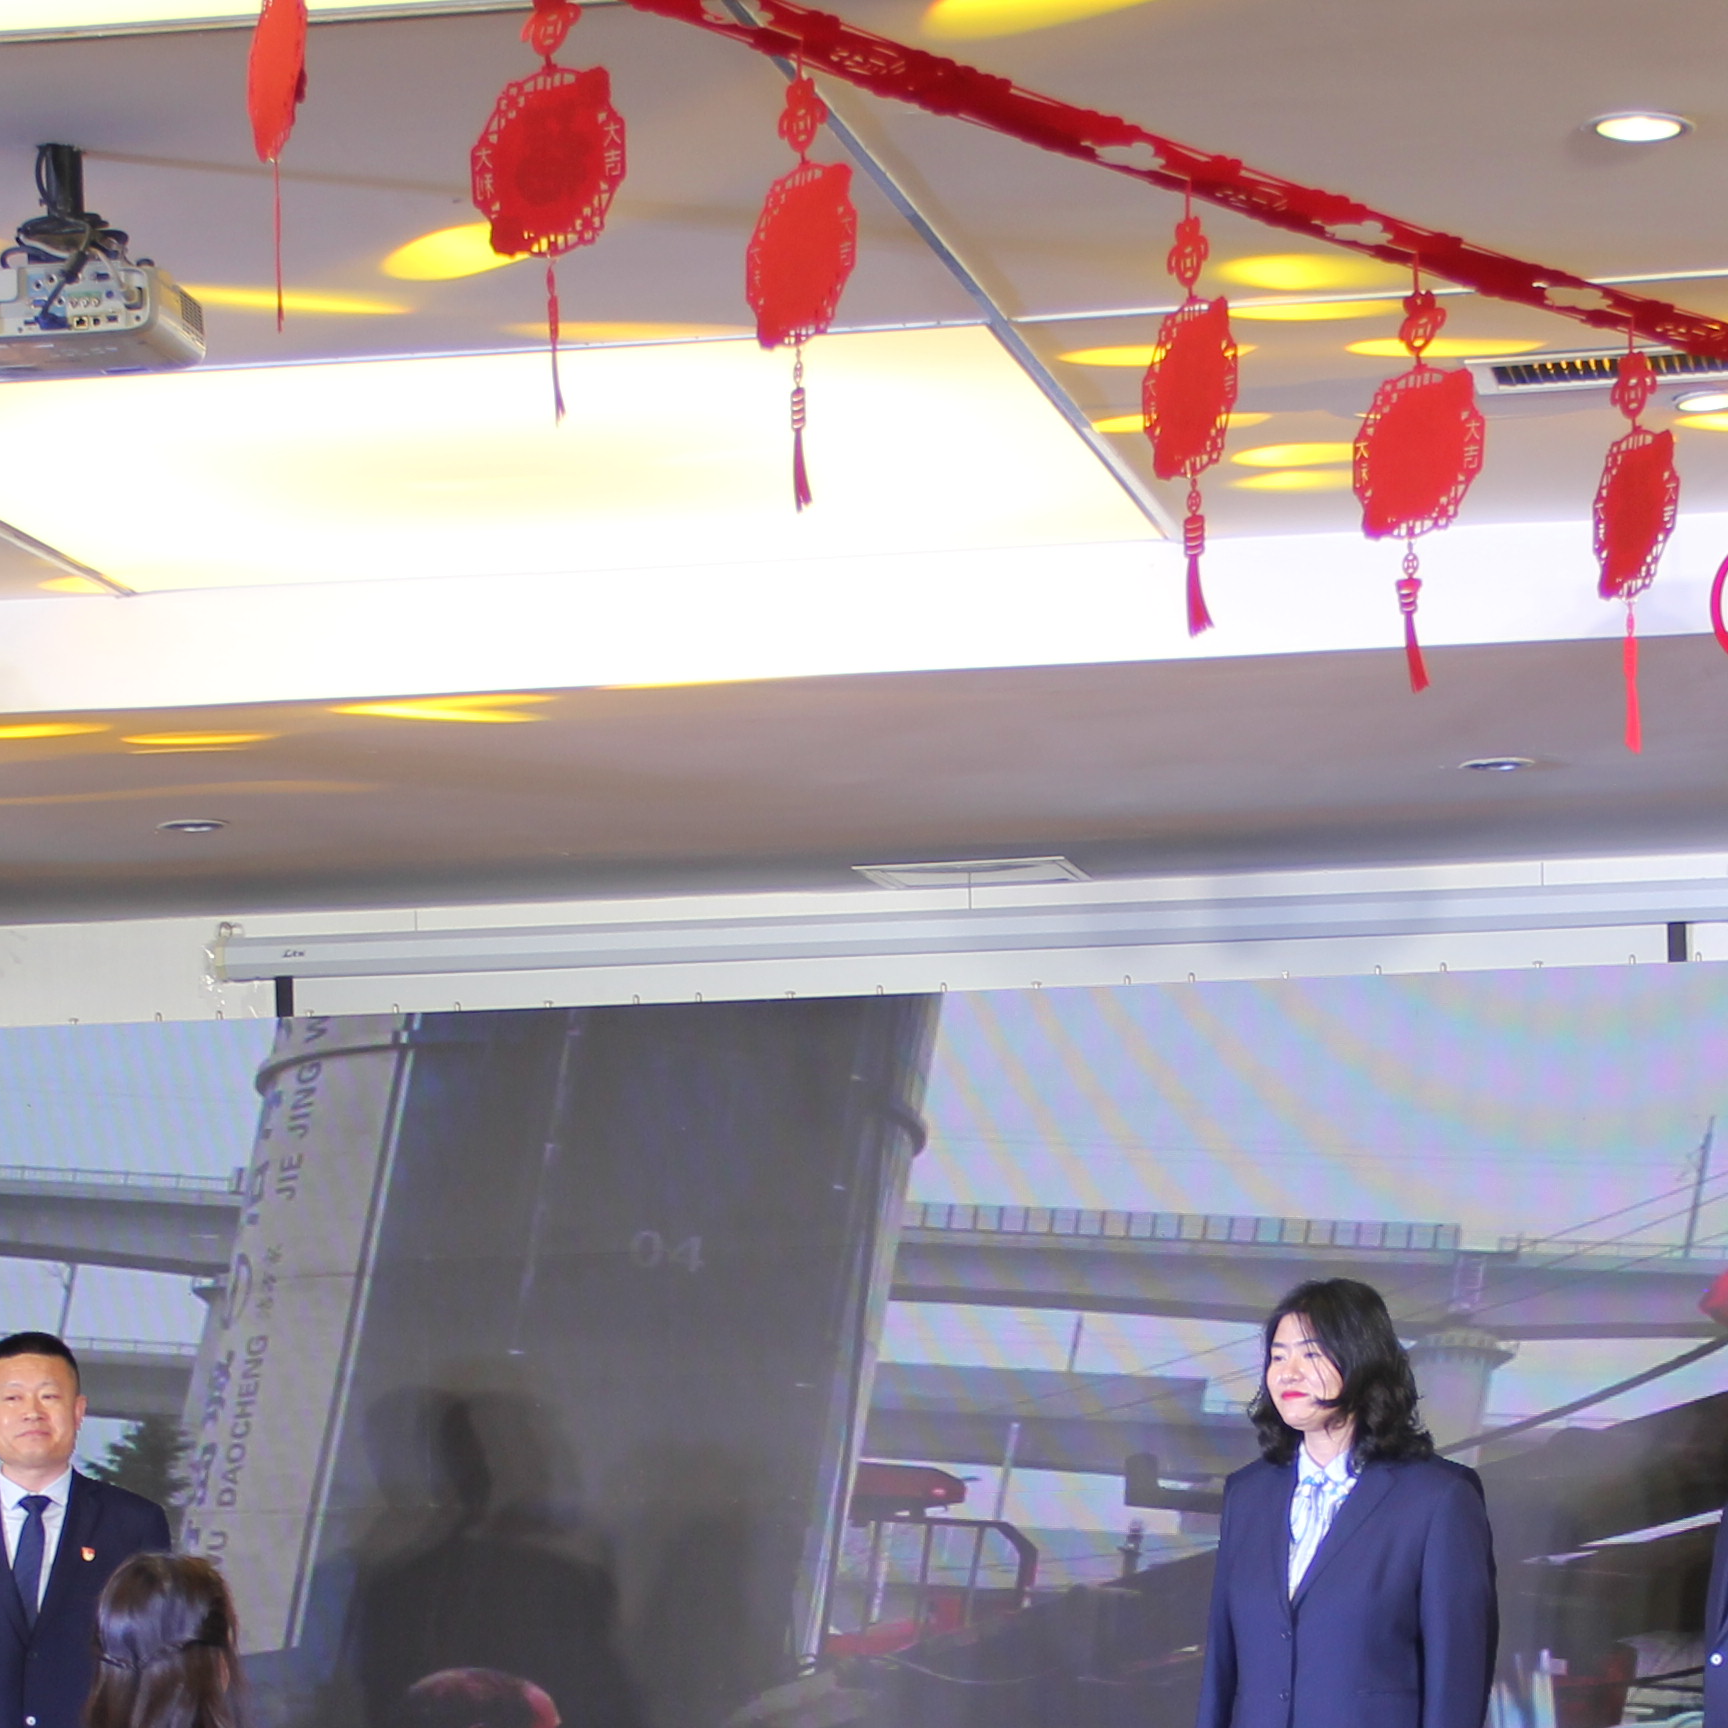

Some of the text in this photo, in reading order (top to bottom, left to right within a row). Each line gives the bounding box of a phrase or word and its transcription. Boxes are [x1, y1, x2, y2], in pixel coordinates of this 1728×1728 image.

[285, 1060, 322, 1140] JING
[275, 1152, 304, 1201] JIE
[215, 1334, 269, 1508] DAOCHENG
